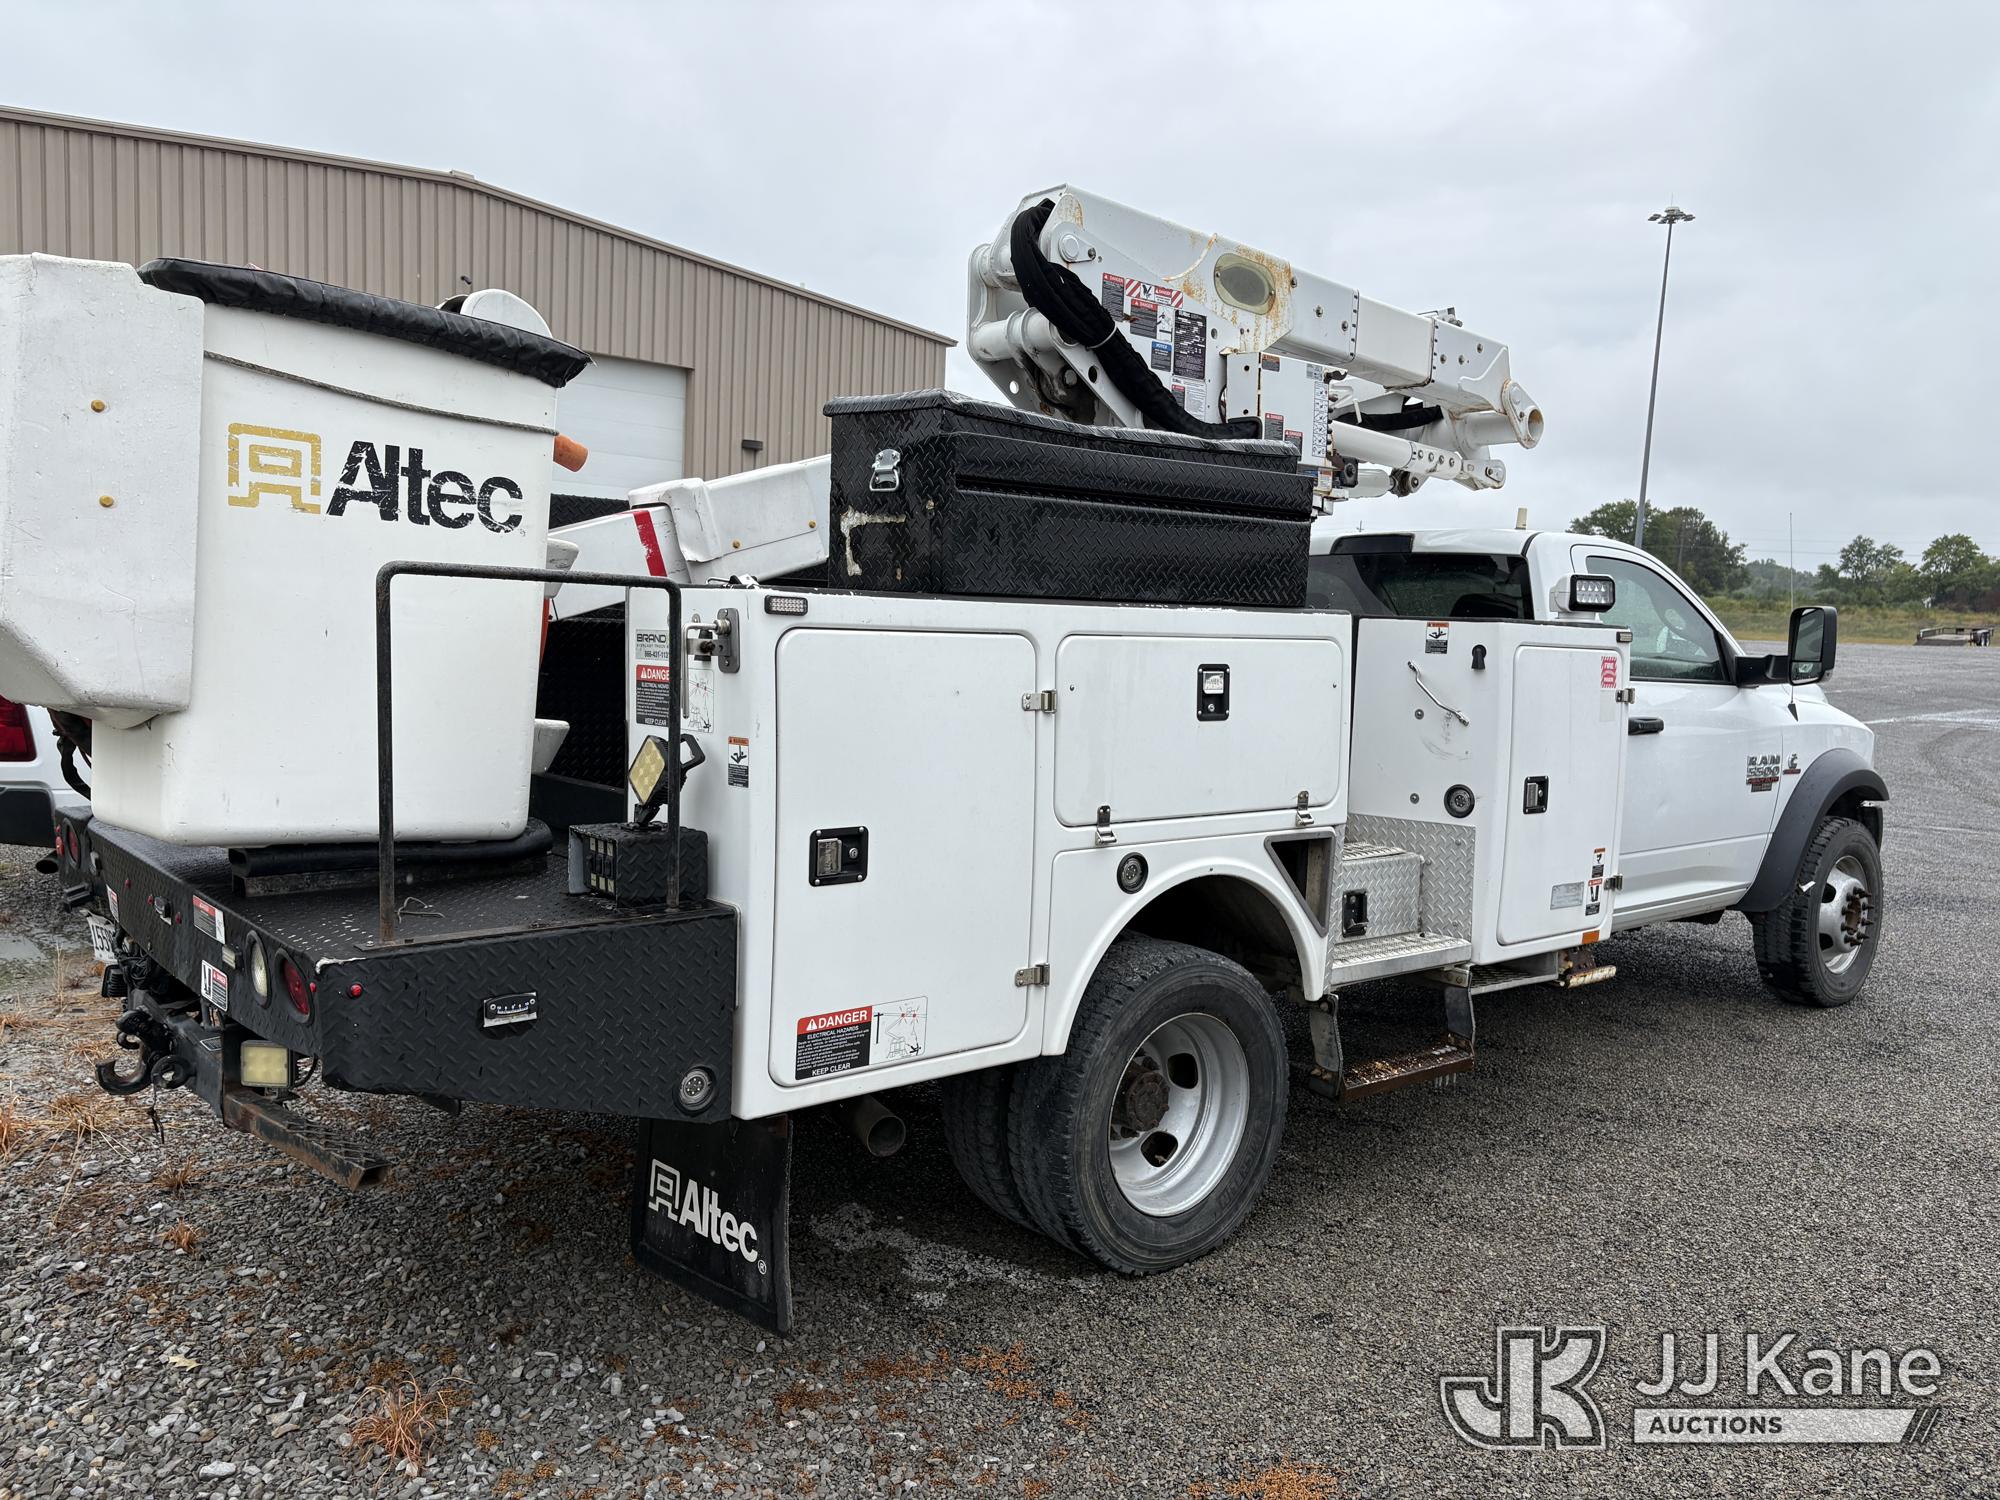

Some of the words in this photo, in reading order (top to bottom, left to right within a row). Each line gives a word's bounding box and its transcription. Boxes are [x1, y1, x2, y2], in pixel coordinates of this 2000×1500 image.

[326, 440, 523, 534] Altec
[647, 668, 670, 681] DANGE
[1747, 755, 1780, 766] RAM
[818, 1010, 868, 1029] DANGER
[807, 1030, 836, 1040] ELECTRICAL
[836, 1025, 860, 1034] HAZARDS
[812, 1066, 829, 1077] KEEP
[829, 1062, 851, 1073] CLEAR
